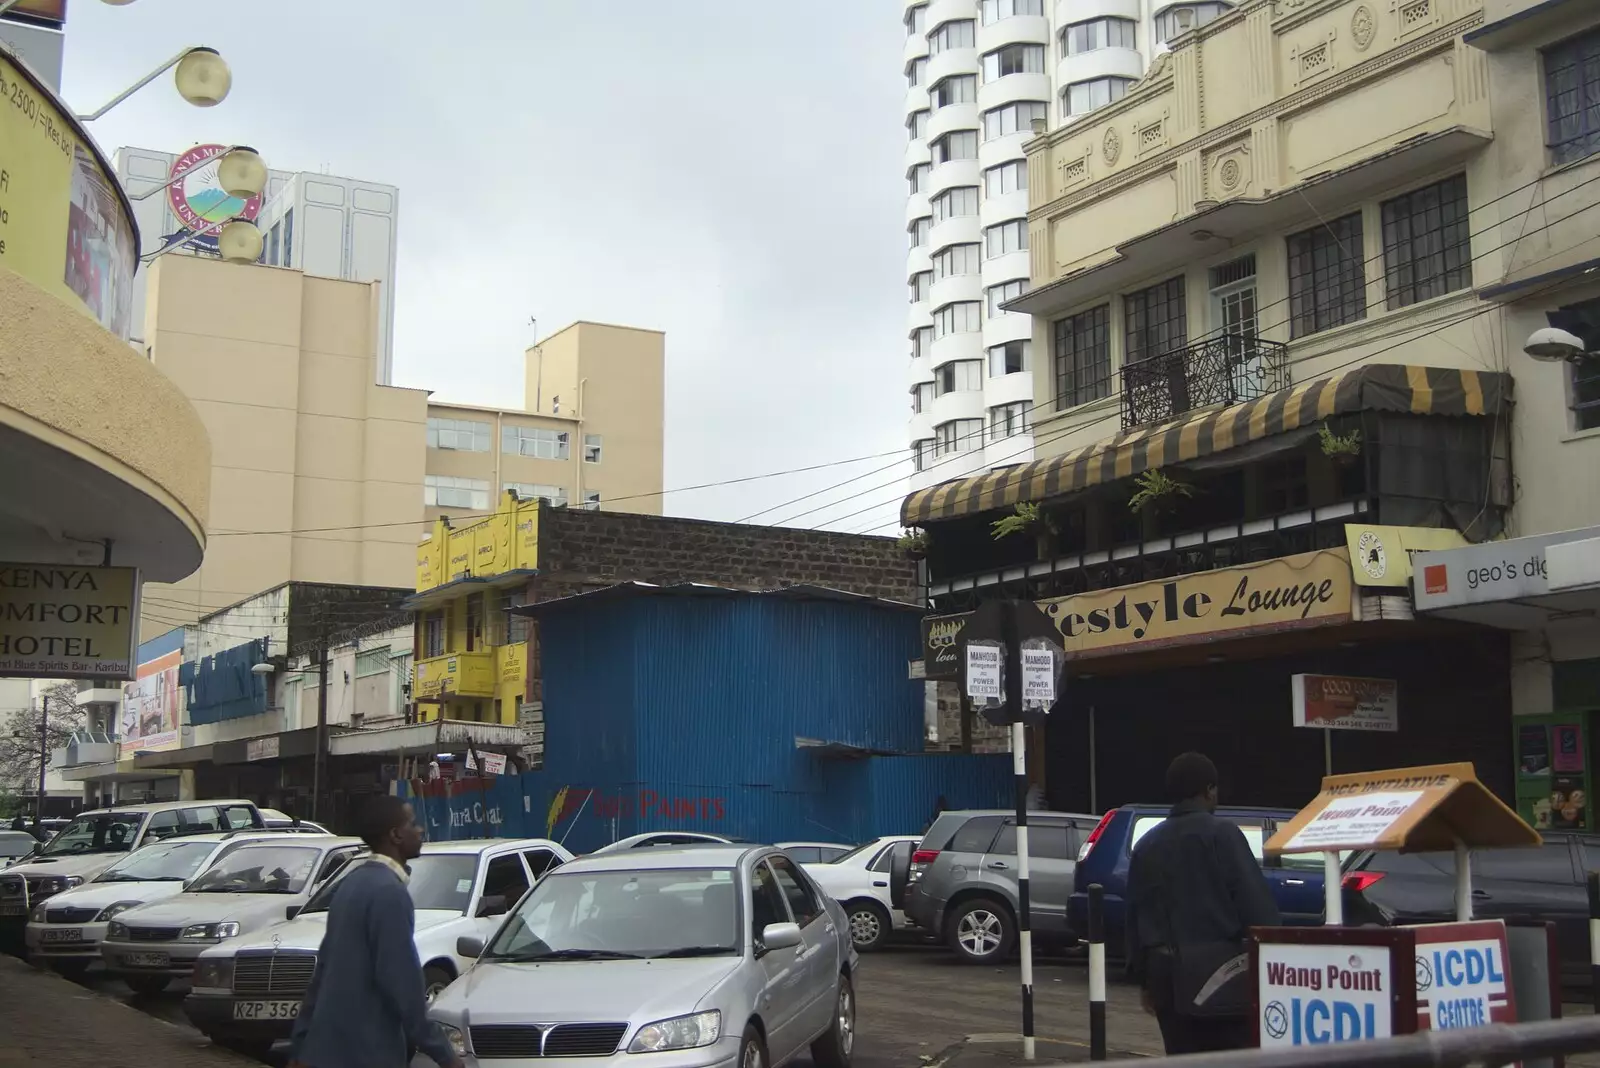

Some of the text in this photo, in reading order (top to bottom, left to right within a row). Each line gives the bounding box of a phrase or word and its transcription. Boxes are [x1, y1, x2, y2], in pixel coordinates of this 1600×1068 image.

[1359, 533, 1383, 552] TUSKER
[1220, 575, 1334, 619] Lounge
[0, 602, 128, 626] MFORT
[970, 651, 998, 662] MANHOOD
[1025, 655, 1052, 666] MANHOOD
[14, 660, 36, 670] Blue
[38, 661, 69, 674] Spirits
[1028, 681, 1049, 689] POWER
[1361, 774, 1451, 793] INITIATIVE
[640, 789, 727, 820] PAINTS
[1317, 804, 1409, 821] Wang Point
[1266, 961, 1382, 992] Wang Point
[1433, 947, 1506, 988] ICDL
[235, 1002, 301, 1018] KZP 356
[1436, 997, 1486, 1030] CENTRE
